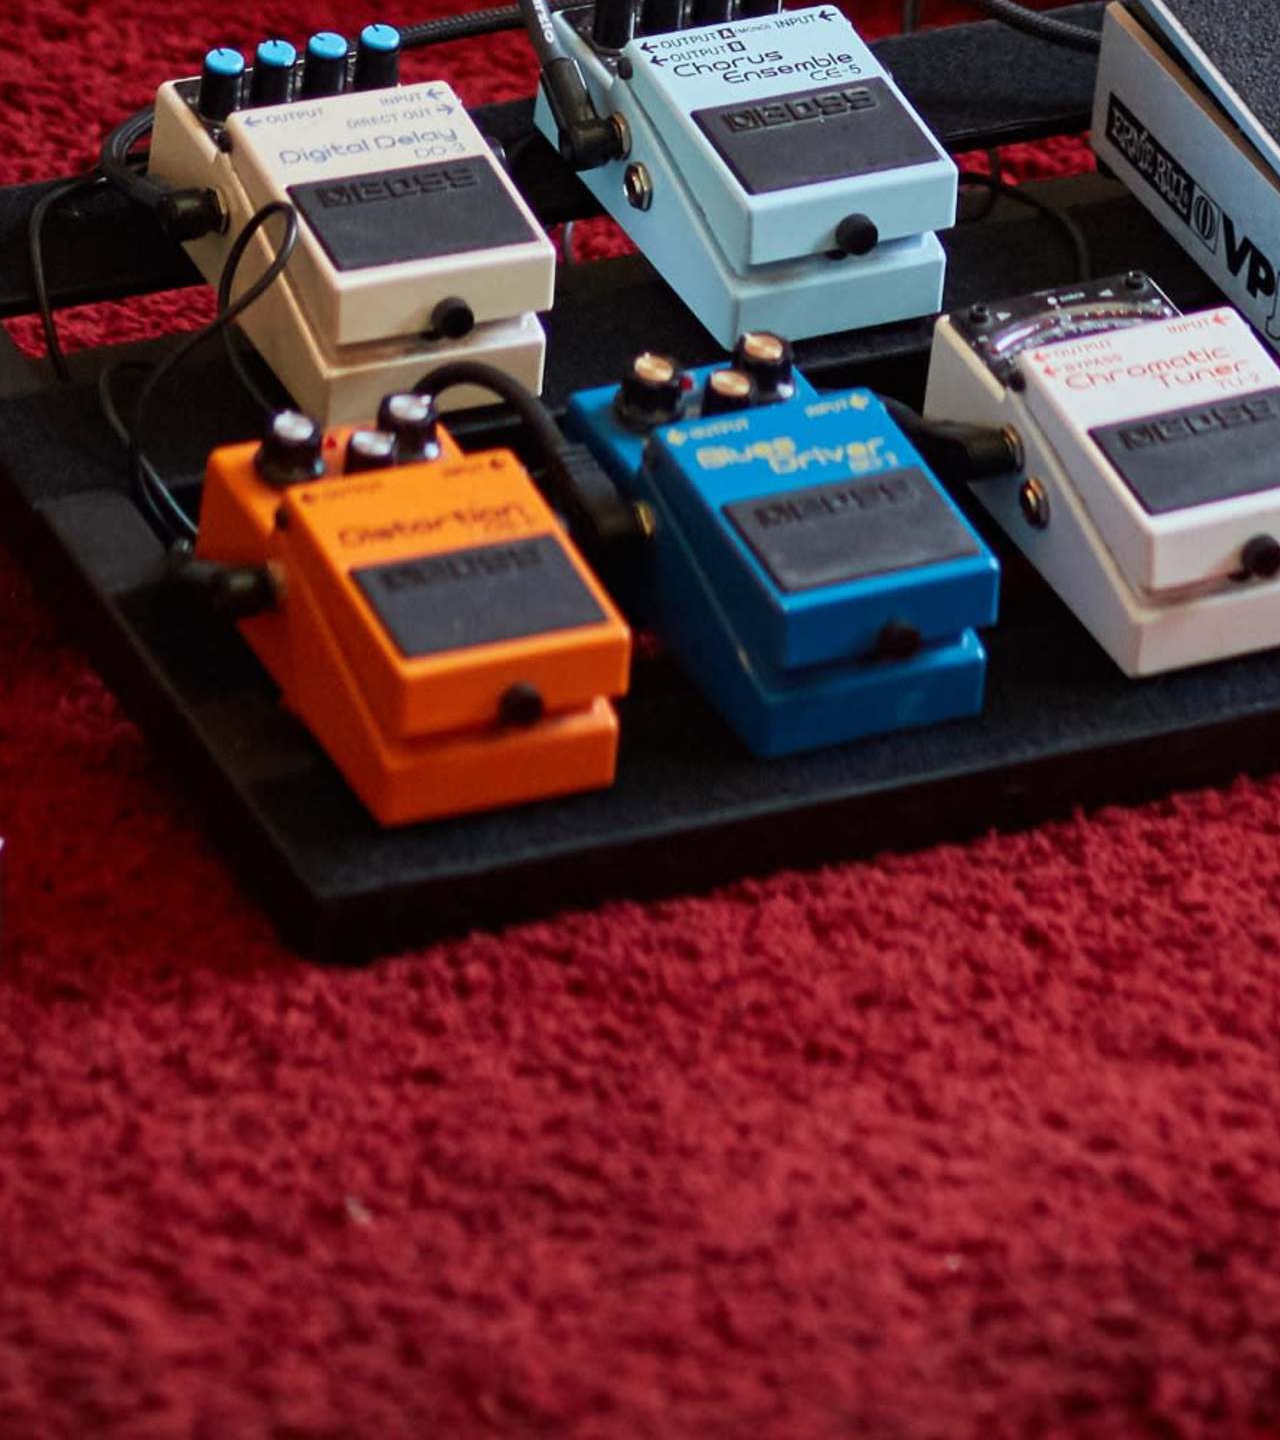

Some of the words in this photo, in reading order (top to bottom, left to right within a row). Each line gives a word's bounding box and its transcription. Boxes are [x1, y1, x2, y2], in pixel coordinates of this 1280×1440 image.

[773, 13, 818, 30] INPUT
[659, 31, 718, 50] OUTPUT
[670, 45, 728, 64] OUTPUT
[672, 50, 784, 79] Chorus
[722, 50, 854, 85] Ensemble
[808, 63, 863, 83] CE-5
[378, 91, 424, 108] INPUT
[403, 106, 433, 123] OUT
[751, 85, 879, 129] BOSS
[265, 106, 325, 126] OUTPUT
[279, 138, 371, 166] Digital
[373, 127, 459, 150] Delay
[1064, 344, 1233, 391] Chromatic
[1153, 357, 1250, 389] Tuner
[695, 436, 796, 470] Blues
[769, 436, 885, 475] Driver
[336, 501, 533, 547] Distortion
